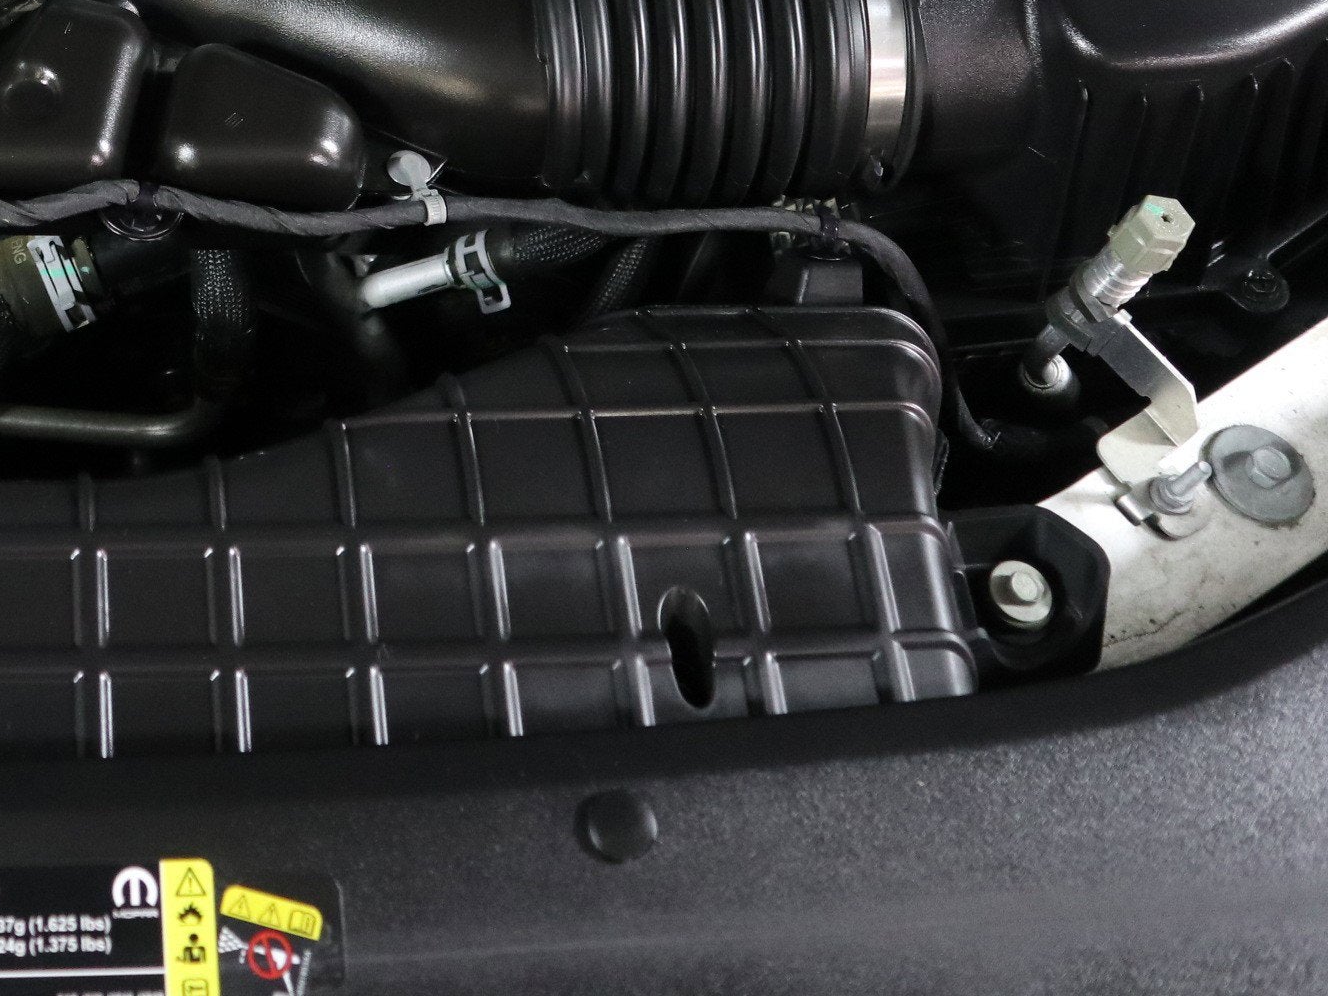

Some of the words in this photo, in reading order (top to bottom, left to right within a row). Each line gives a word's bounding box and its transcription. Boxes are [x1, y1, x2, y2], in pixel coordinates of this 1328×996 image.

[28, 914, 78, 937] (1.625
[79, 913, 113, 936] lbs)
[28, 934, 79, 957] (1.375
[79, 934, 113, 956] lbs)
